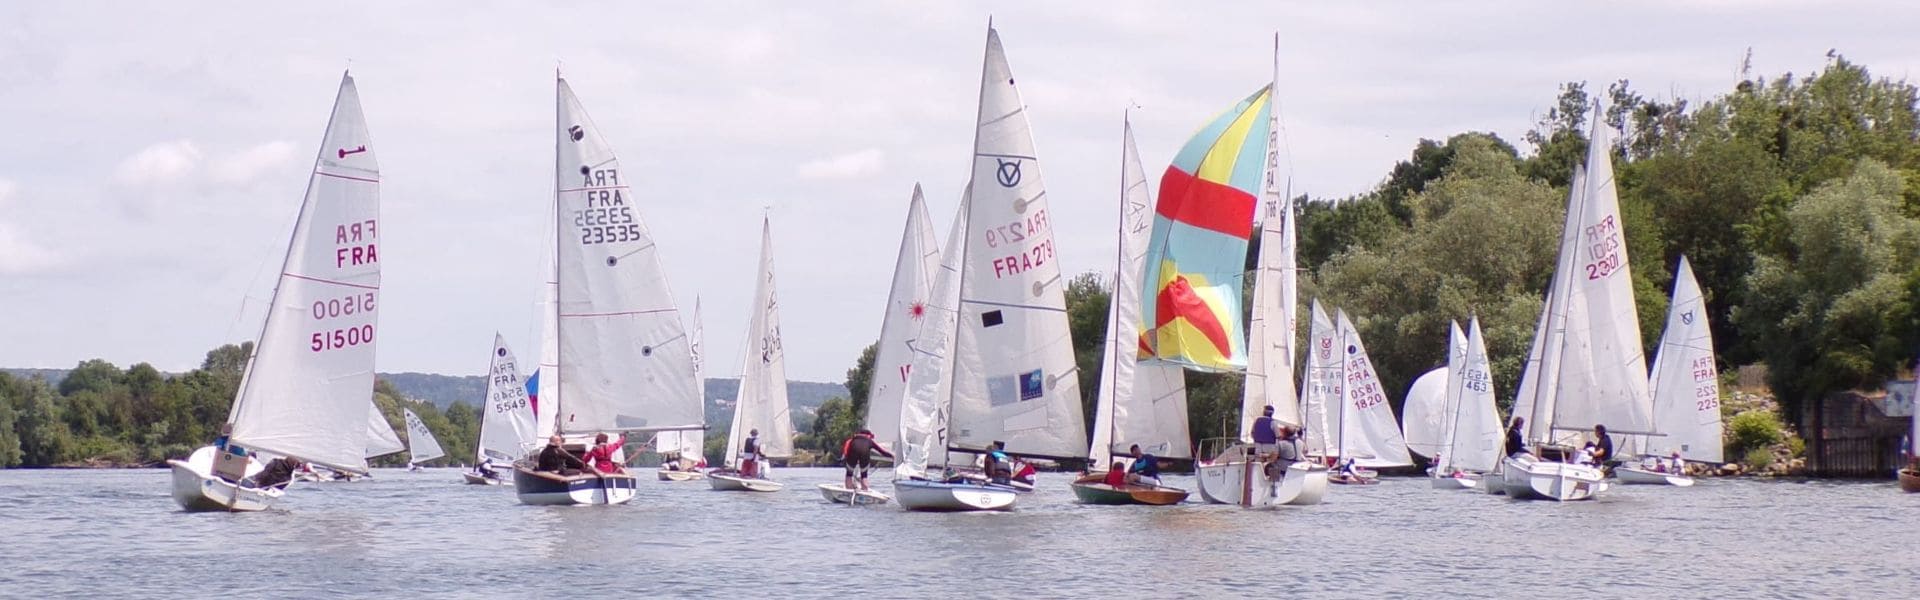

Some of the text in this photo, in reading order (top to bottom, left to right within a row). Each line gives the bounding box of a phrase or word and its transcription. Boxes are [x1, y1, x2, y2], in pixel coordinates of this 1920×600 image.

[588, 189, 623, 208] FRA
[581, 224, 641, 245] 23535
[337, 244, 377, 269] FRA
[993, 239, 1052, 280] FRA 279
[1585, 251, 1619, 281] 2301
[311, 324, 373, 352] 51500
[494, 373, 517, 387] FRA
[1347, 369, 1370, 385] FRA
[1693, 369, 1715, 382] FRA
[1465, 380, 1487, 393] 463
[496, 398, 526, 414] 5549
[1354, 393, 1382, 411] 1820
[1697, 398, 1718, 412] 225
